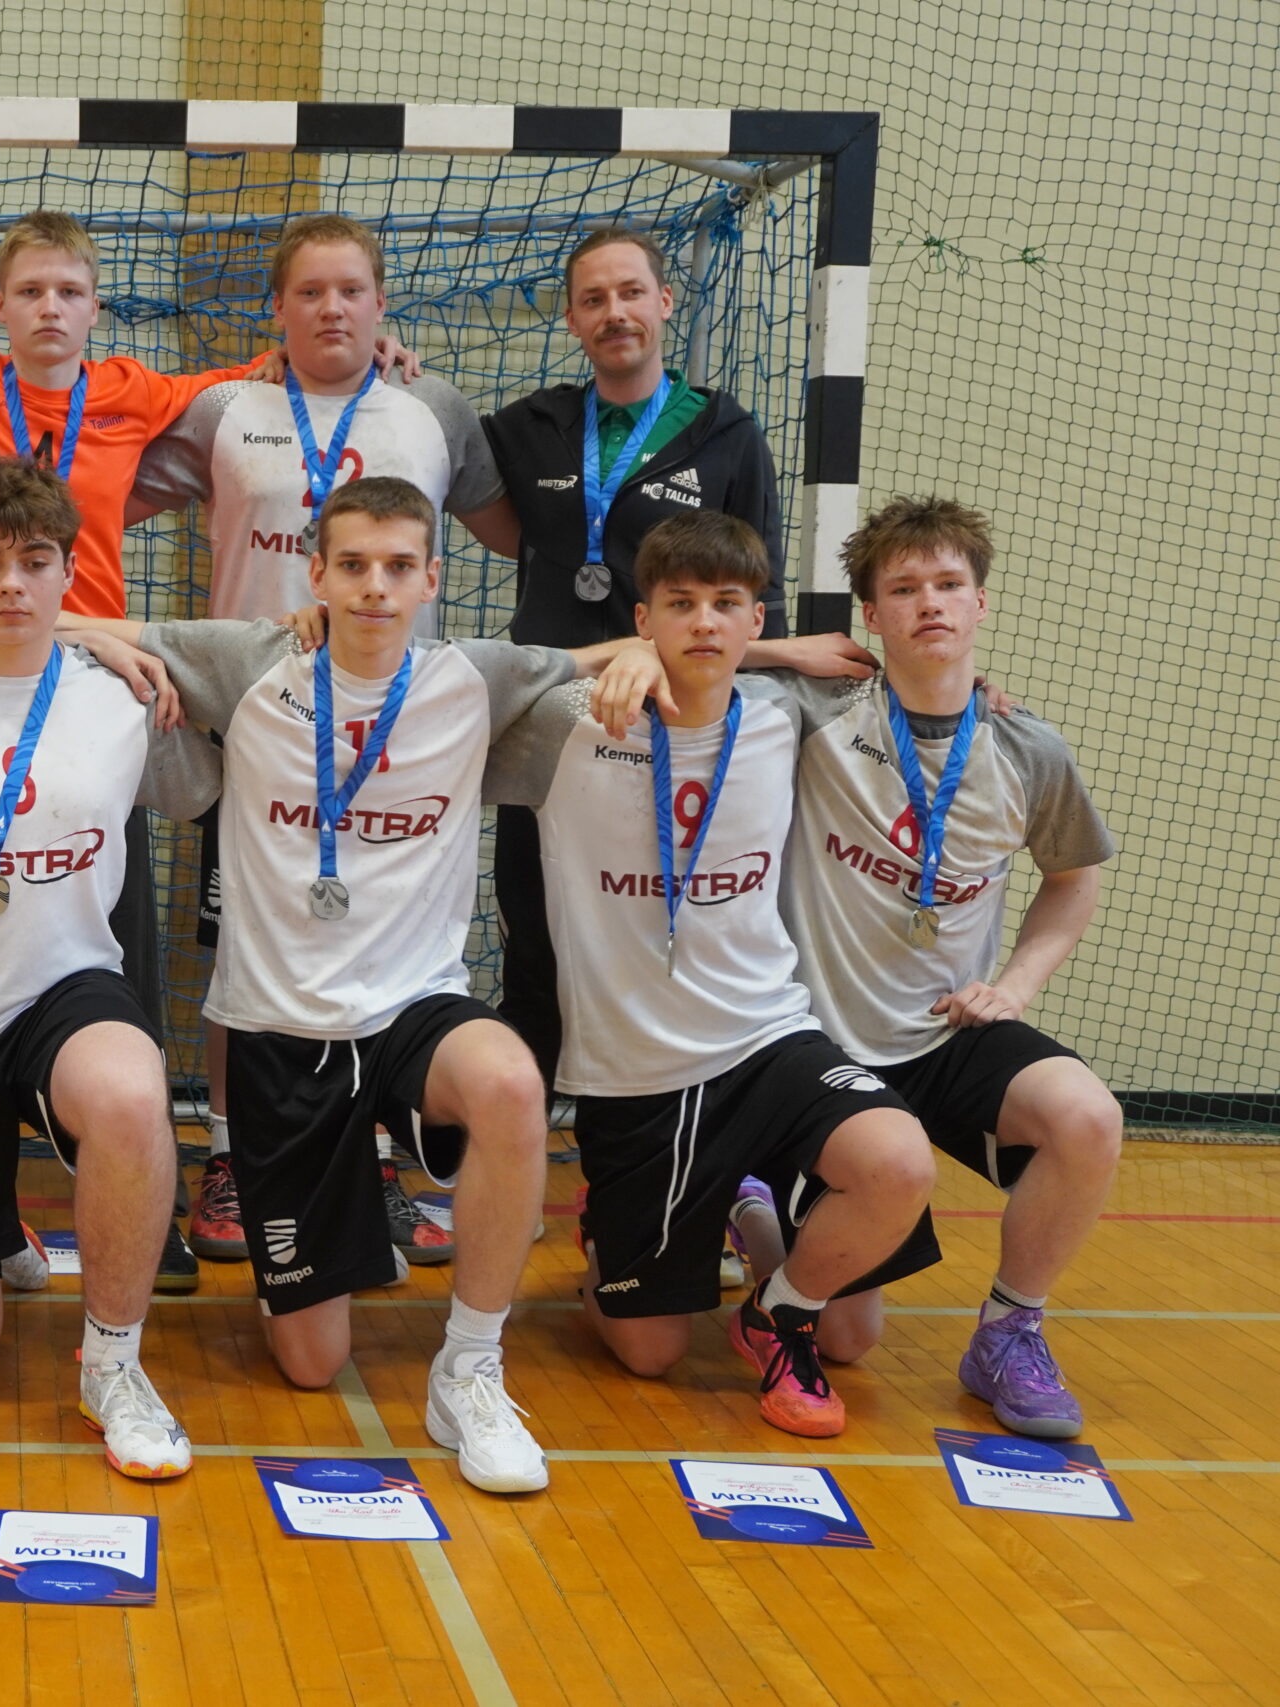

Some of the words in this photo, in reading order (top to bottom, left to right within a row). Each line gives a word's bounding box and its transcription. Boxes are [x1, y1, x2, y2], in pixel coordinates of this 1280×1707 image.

[90, 414, 125, 430] Tallinn
[243, 432, 292, 447] Kempa
[537, 476, 577, 490] MISTRA
[670, 474, 702, 494] adidas
[665, 487, 702, 508] TALLAS
[280, 687, 317, 722] Kemp
[673, 780, 710, 849] 9
[263, 1265, 314, 1286] Kempa
[976, 1469, 1086, 1484] DIPLOM
[297, 1495, 404, 1505] DIPLOM
[711, 1491, 821, 1505] DIPLOM
[15, 1547, 126, 1560] DIPLOM
